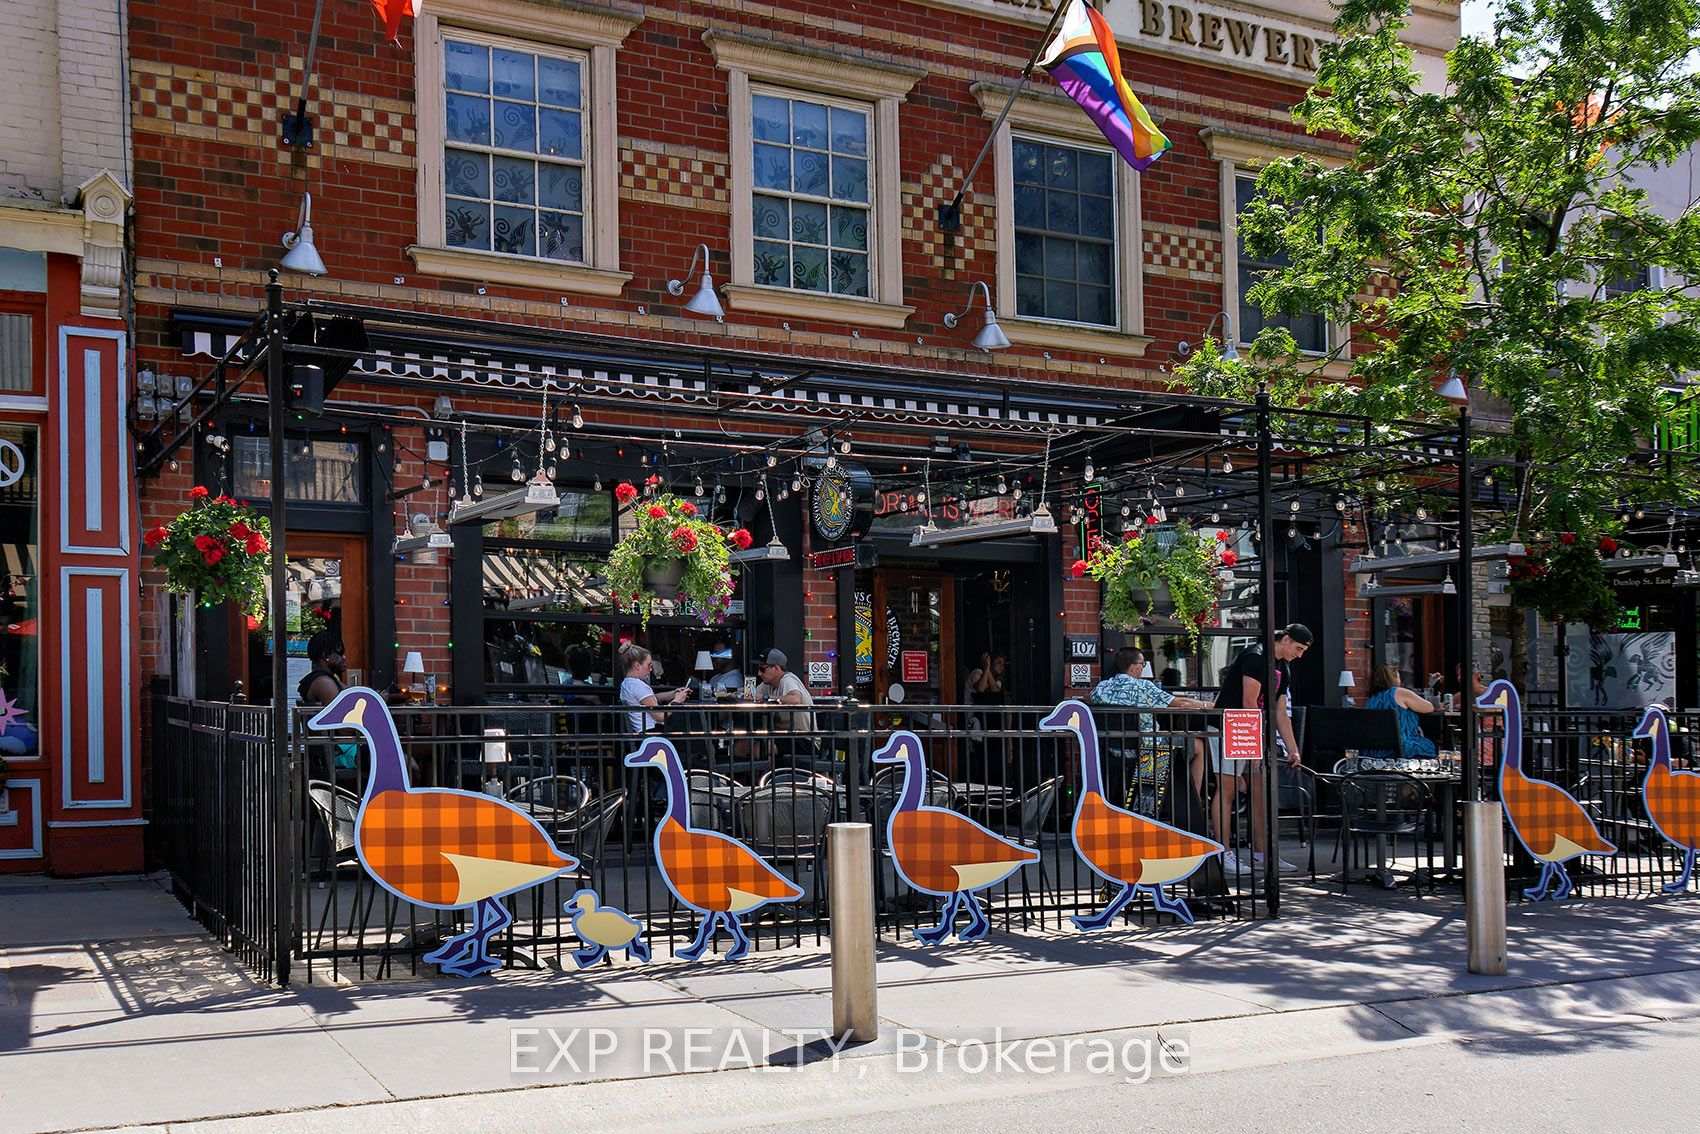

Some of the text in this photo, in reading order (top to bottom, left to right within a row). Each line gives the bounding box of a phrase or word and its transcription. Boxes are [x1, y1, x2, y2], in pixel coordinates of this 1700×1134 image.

[1139, 0, 1328, 71] BREWER
[1613, 578, 1641, 588] Dunlop
[1655, 576, 1671, 585] East
[888, 616, 901, 669] Brewer
[1072, 641, 1096, 655] 107
